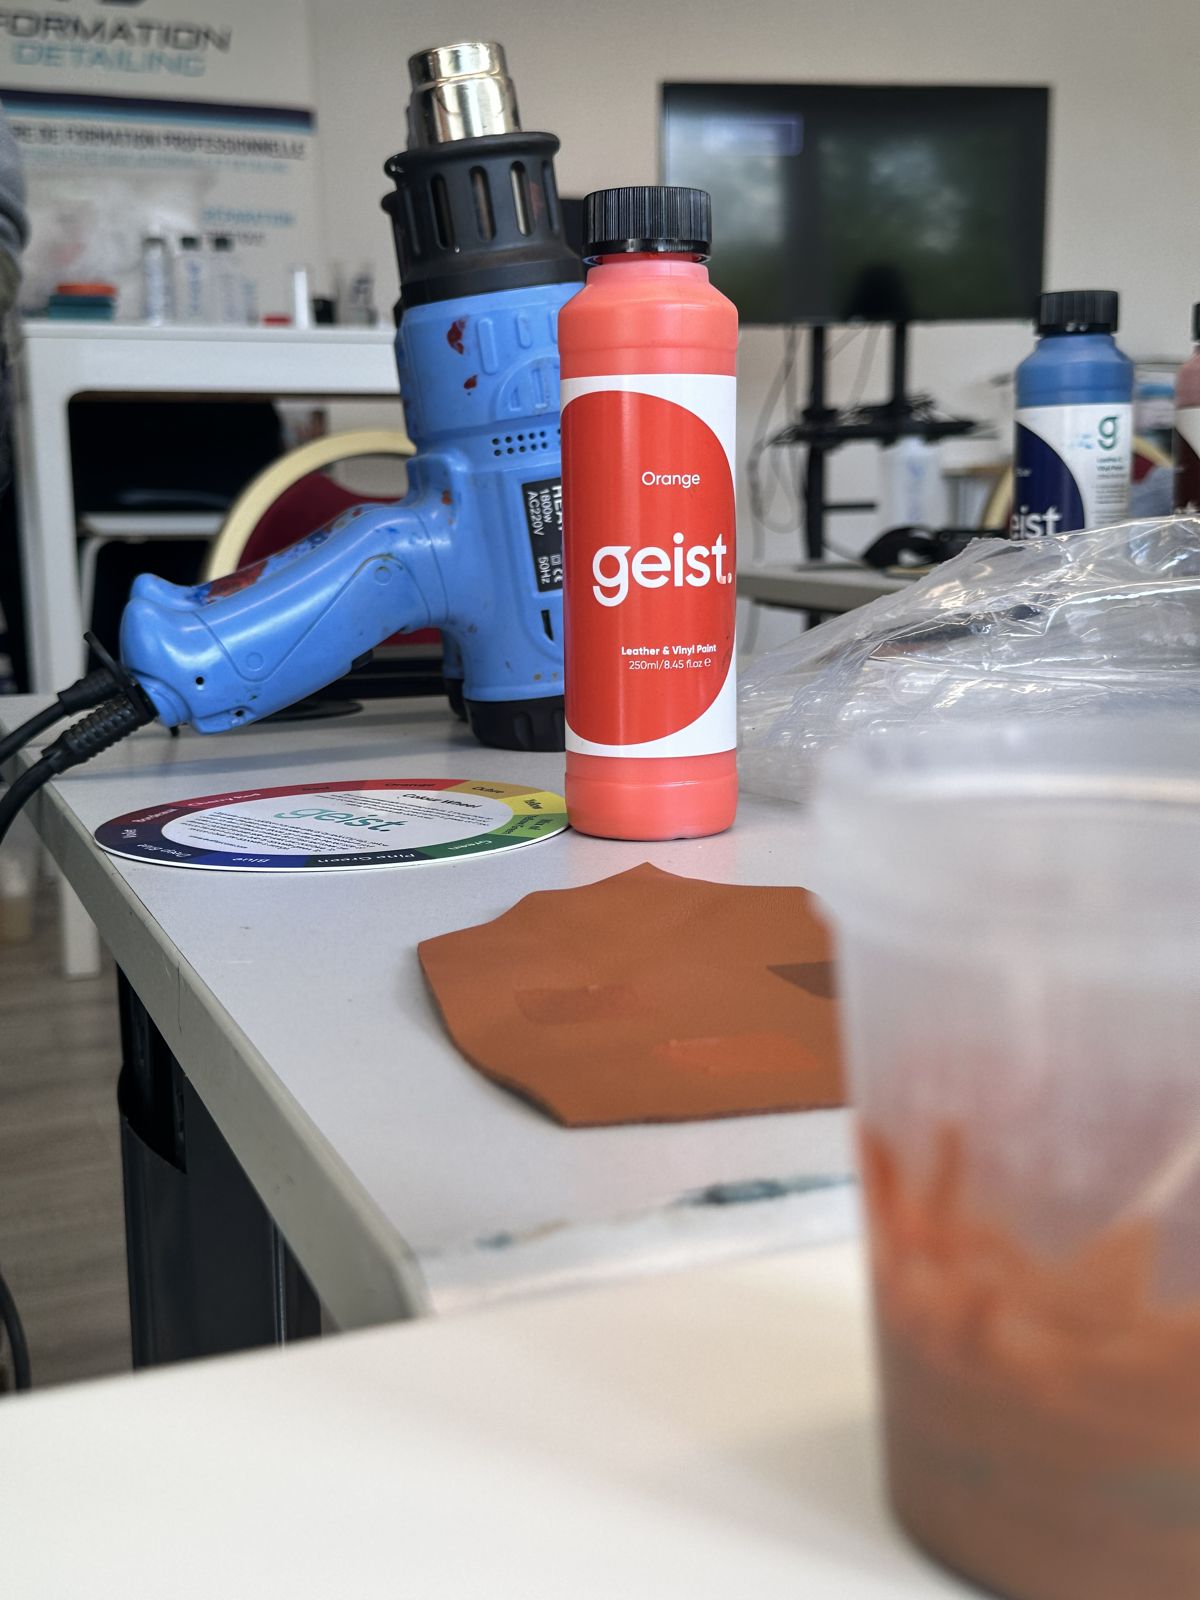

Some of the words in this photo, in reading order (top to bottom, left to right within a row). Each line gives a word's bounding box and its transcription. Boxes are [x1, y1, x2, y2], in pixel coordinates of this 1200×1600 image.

[0, 11, 232, 52] ORMATION
[13, 41, 206, 77] DETAILING
[66, 127, 155, 149] FORMATION
[641, 471, 700, 489] Orange
[528, 491, 545, 536] AC220V
[1010, 504, 1062, 540] eist
[592, 532, 732, 607] geist.
[621, 646, 660, 656] Leather
[662, 646, 670, 656] &
[672, 645, 695, 656] Vinyl
[696, 644, 717, 654] Paint
[402, 793, 441, 802] Colour
[441, 799, 483, 809] Wheel
[448, 839, 493, 850] Green
